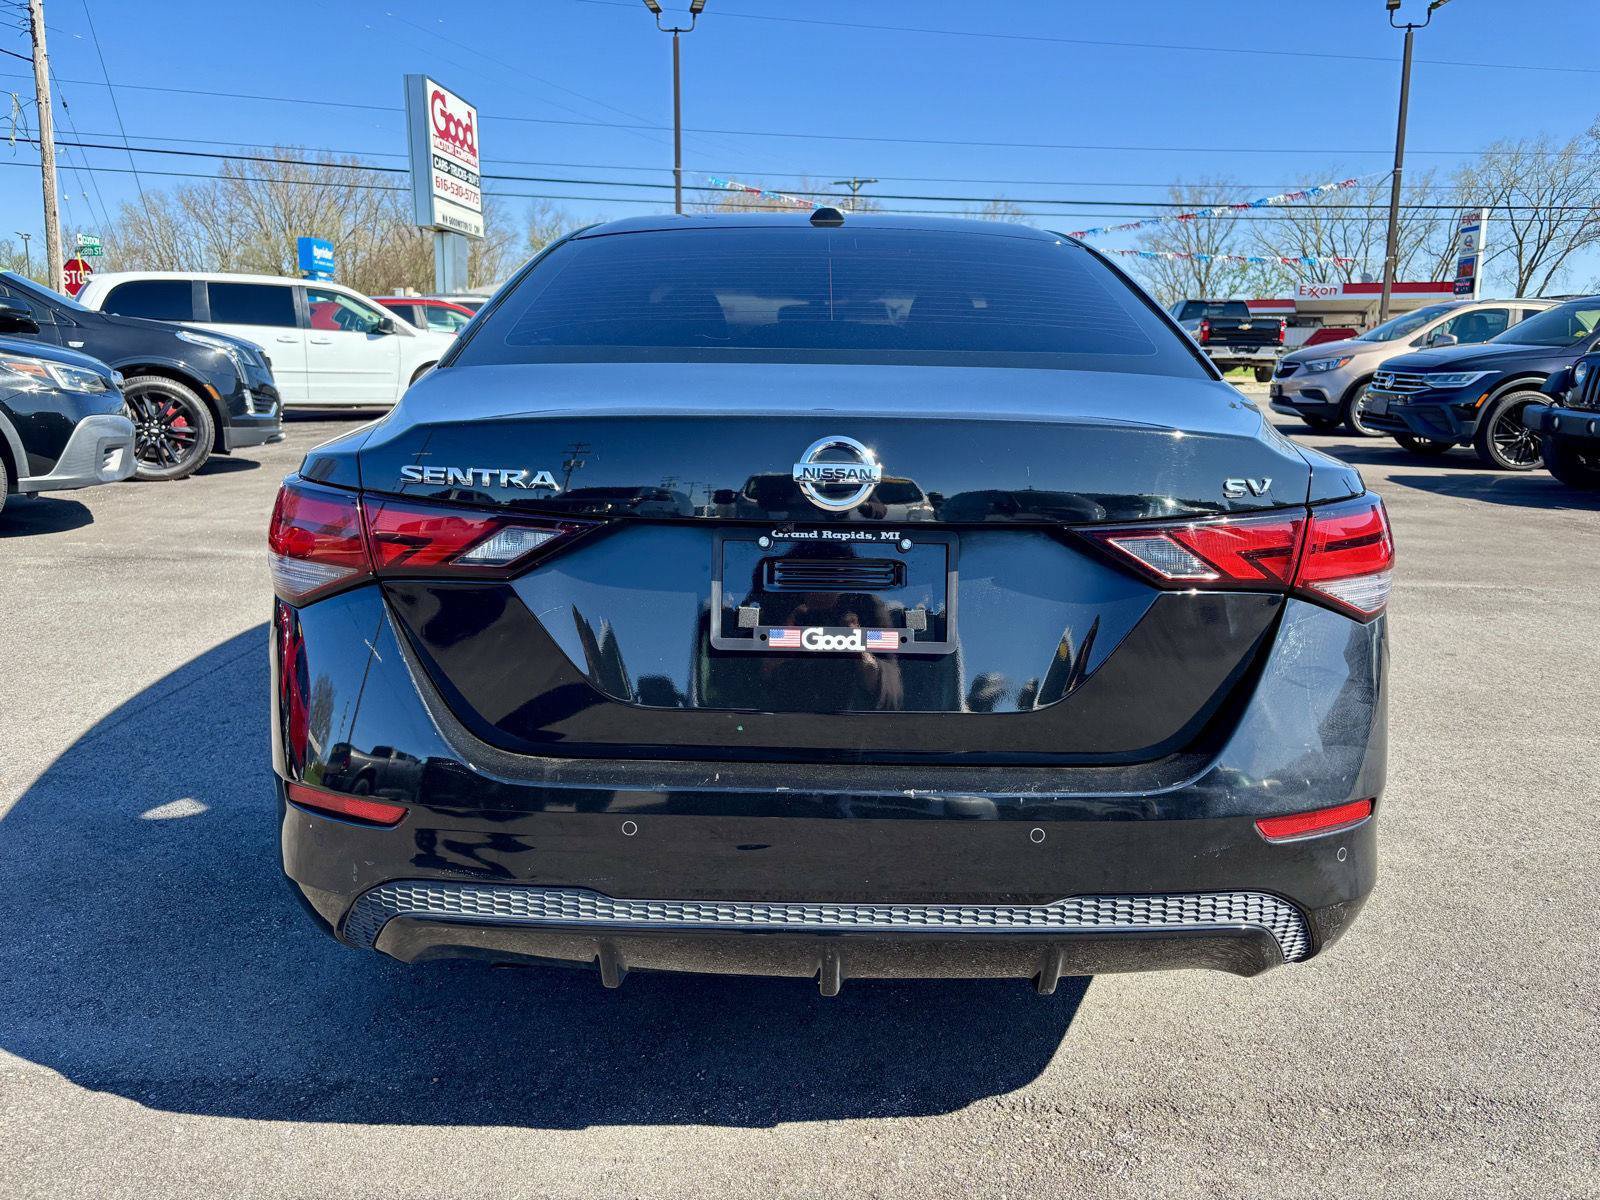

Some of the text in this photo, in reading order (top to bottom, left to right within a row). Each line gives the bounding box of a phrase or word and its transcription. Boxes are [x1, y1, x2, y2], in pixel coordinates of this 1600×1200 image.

[431, 90, 477, 156] Good
[435, 176, 480, 204] 616-530-5775
[1298, 284, 1338, 299] Exxon
[400, 464, 561, 492] SENTRA
[802, 467, 872, 480] NISSAN
[1222, 478, 1273, 498] SV
[771, 529, 900, 541] Grand Rapids, MI
